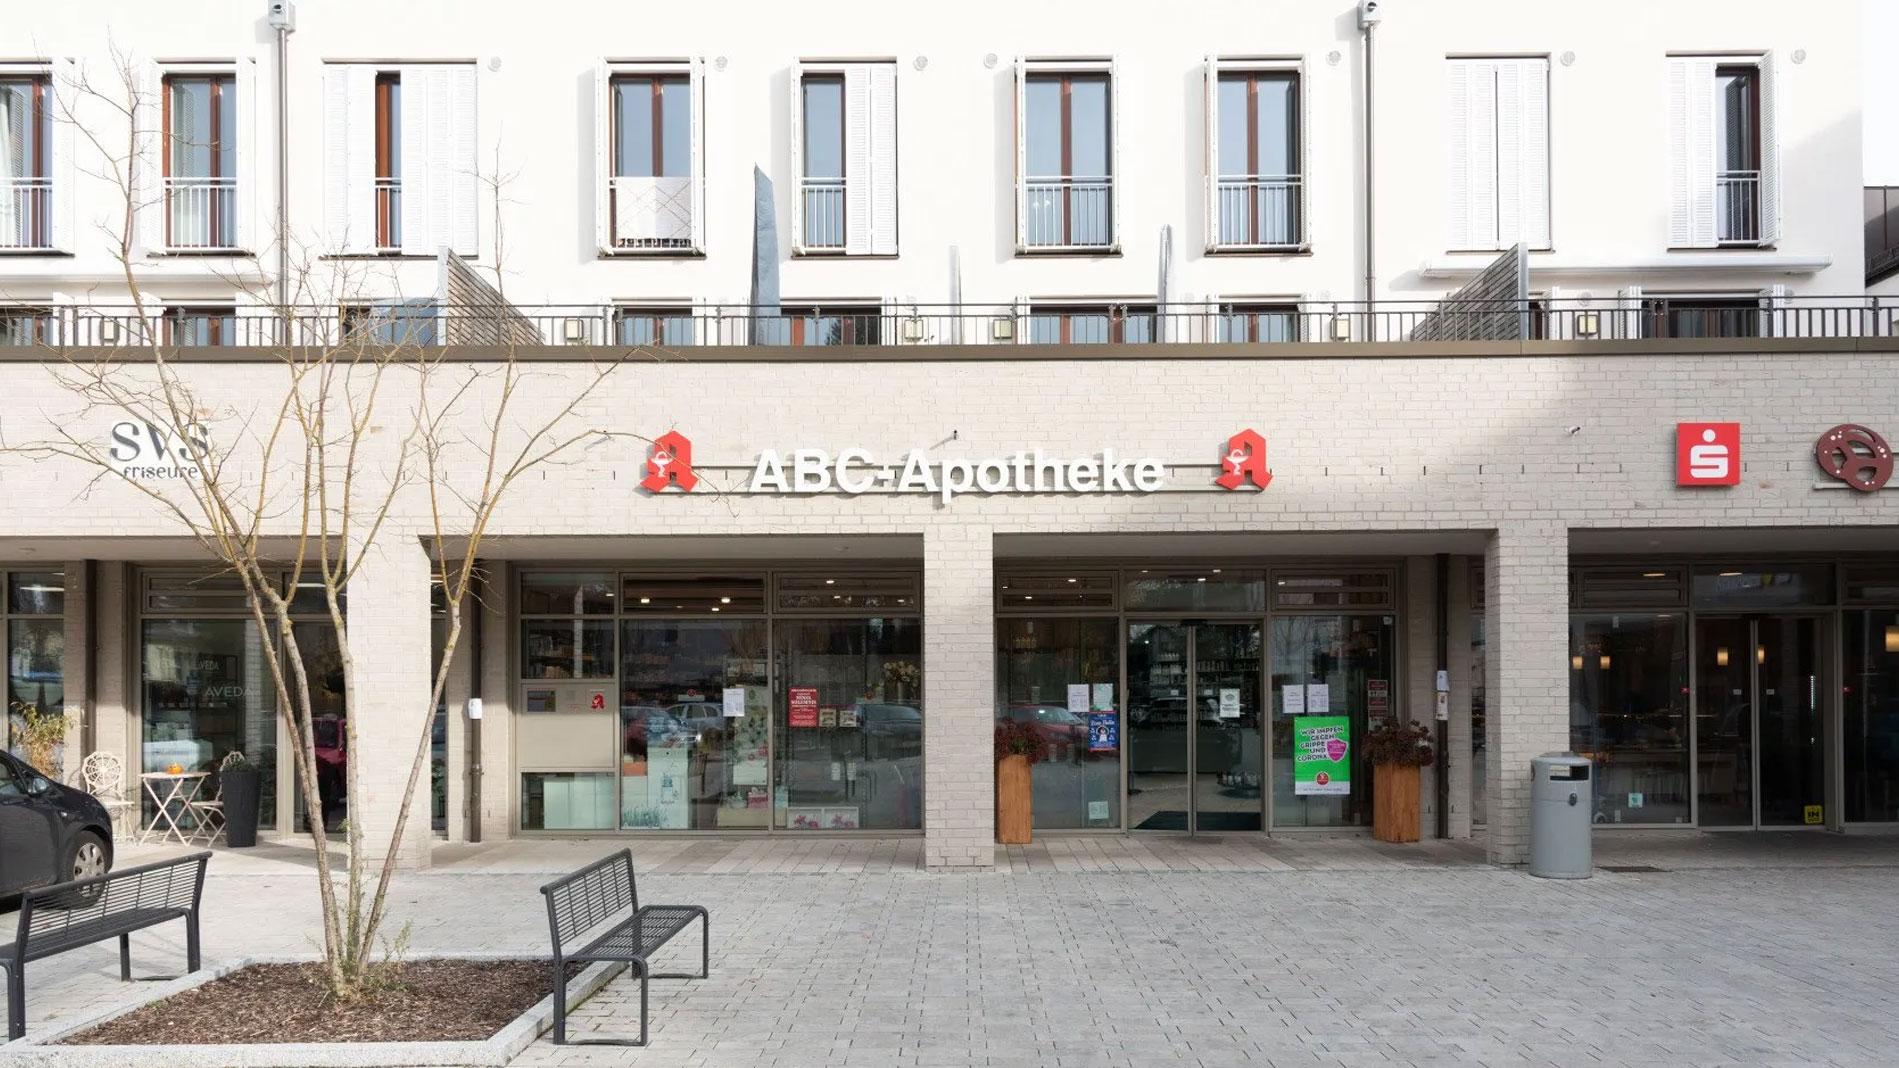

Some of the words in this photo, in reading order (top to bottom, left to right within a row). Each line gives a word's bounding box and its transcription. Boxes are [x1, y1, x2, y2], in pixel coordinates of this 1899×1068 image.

[110, 422, 208, 462] SVS
[123, 466, 198, 479] friseure
[750, 448, 1166, 504] ABC-Apotheke
[1316, 726, 1344, 734] IMPFEN
[1300, 741, 1326, 749] GRIPPE
